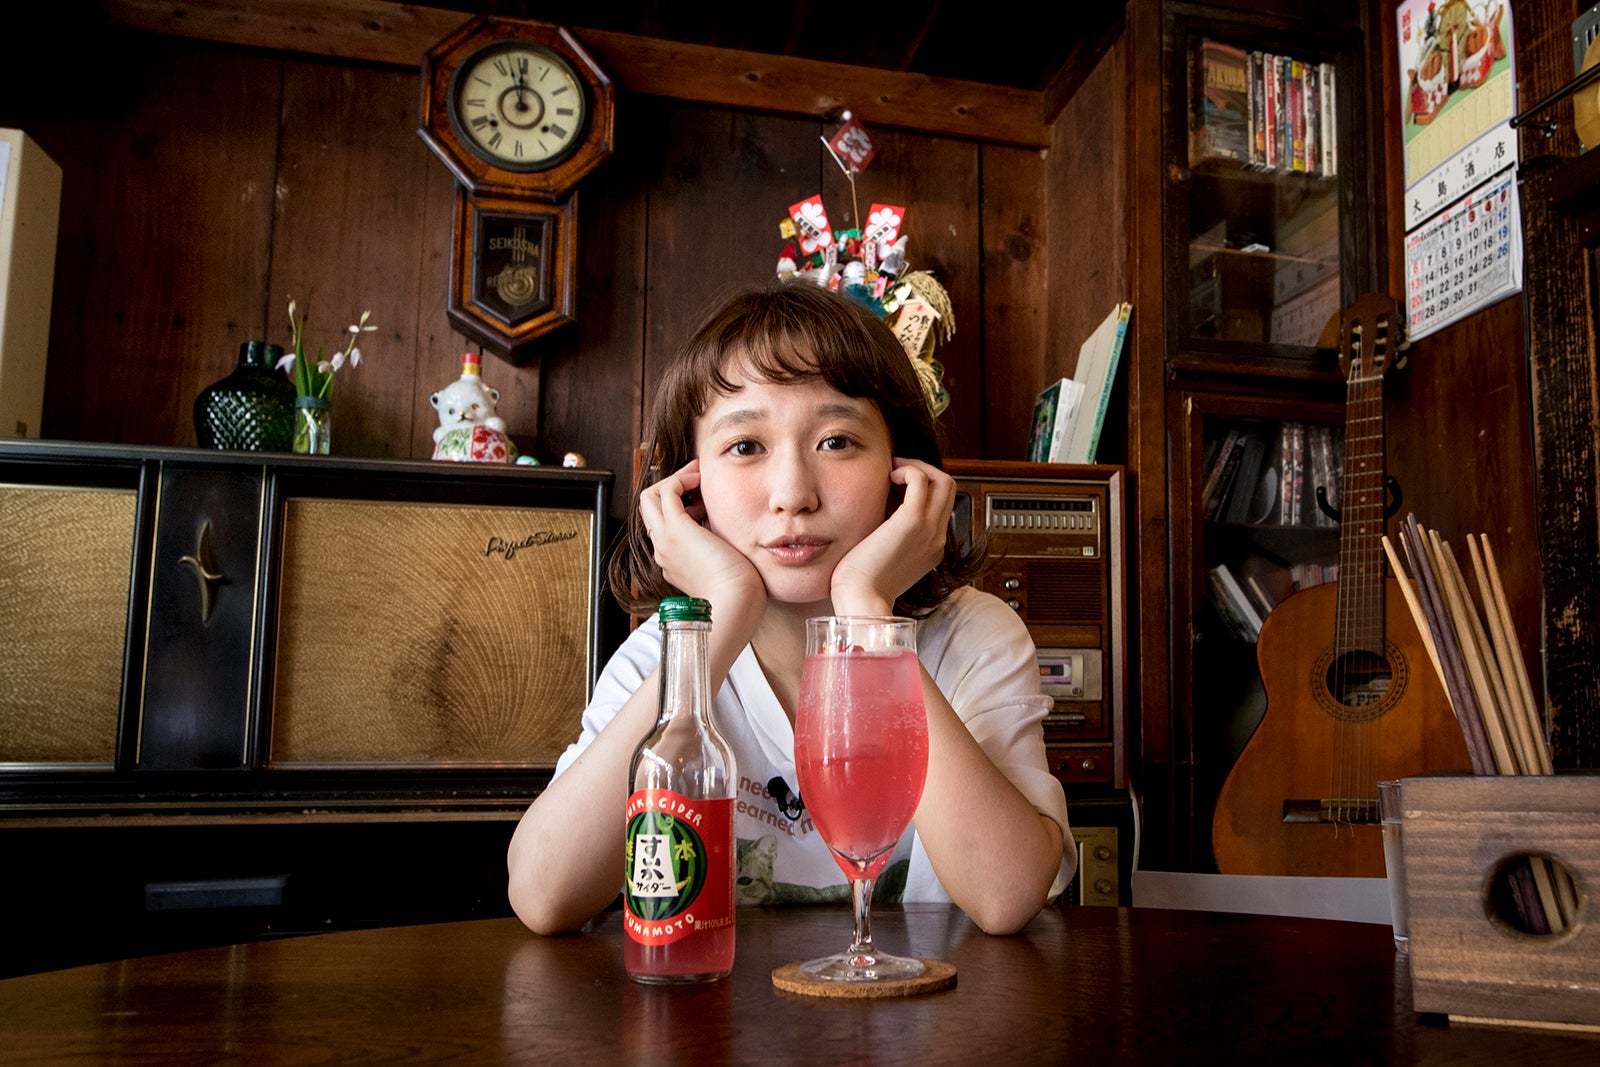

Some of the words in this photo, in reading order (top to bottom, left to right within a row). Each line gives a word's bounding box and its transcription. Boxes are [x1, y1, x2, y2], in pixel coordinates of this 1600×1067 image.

[1468, 227, 1479, 241] 10
[1484, 218, 1493, 232] 11
[1498, 206, 1507, 221] 12
[1411, 278, 1421, 292] 13
[1425, 271, 1434, 284] 14
[1440, 262, 1449, 276] 15
[1454, 254, 1464, 268] 16
[1469, 245, 1478, 259] 17
[1483, 236, 1493, 250] 18
[1498, 225, 1508, 240] 19
[1425, 288, 1434, 302] 21
[1439, 279, 1449, 294] 22
[1454, 271, 1464, 286] 23
[1468, 263, 1478, 278] 24
[1483, 253, 1493, 269] 25
[1411, 310, 1422, 326] 27
[1425, 305, 1435, 319] 28
[1439, 297, 1449, 311] 29
[1453, 289, 1464, 304] 30
[1467, 281, 1477, 296] 31
[739, 776, 777, 803] nee
[658, 797, 702, 826] CIDER
[640, 836, 664, 881] すいか
[636, 881, 672, 893] サイダー
[625, 909, 695, 937] KUMAMOTO
